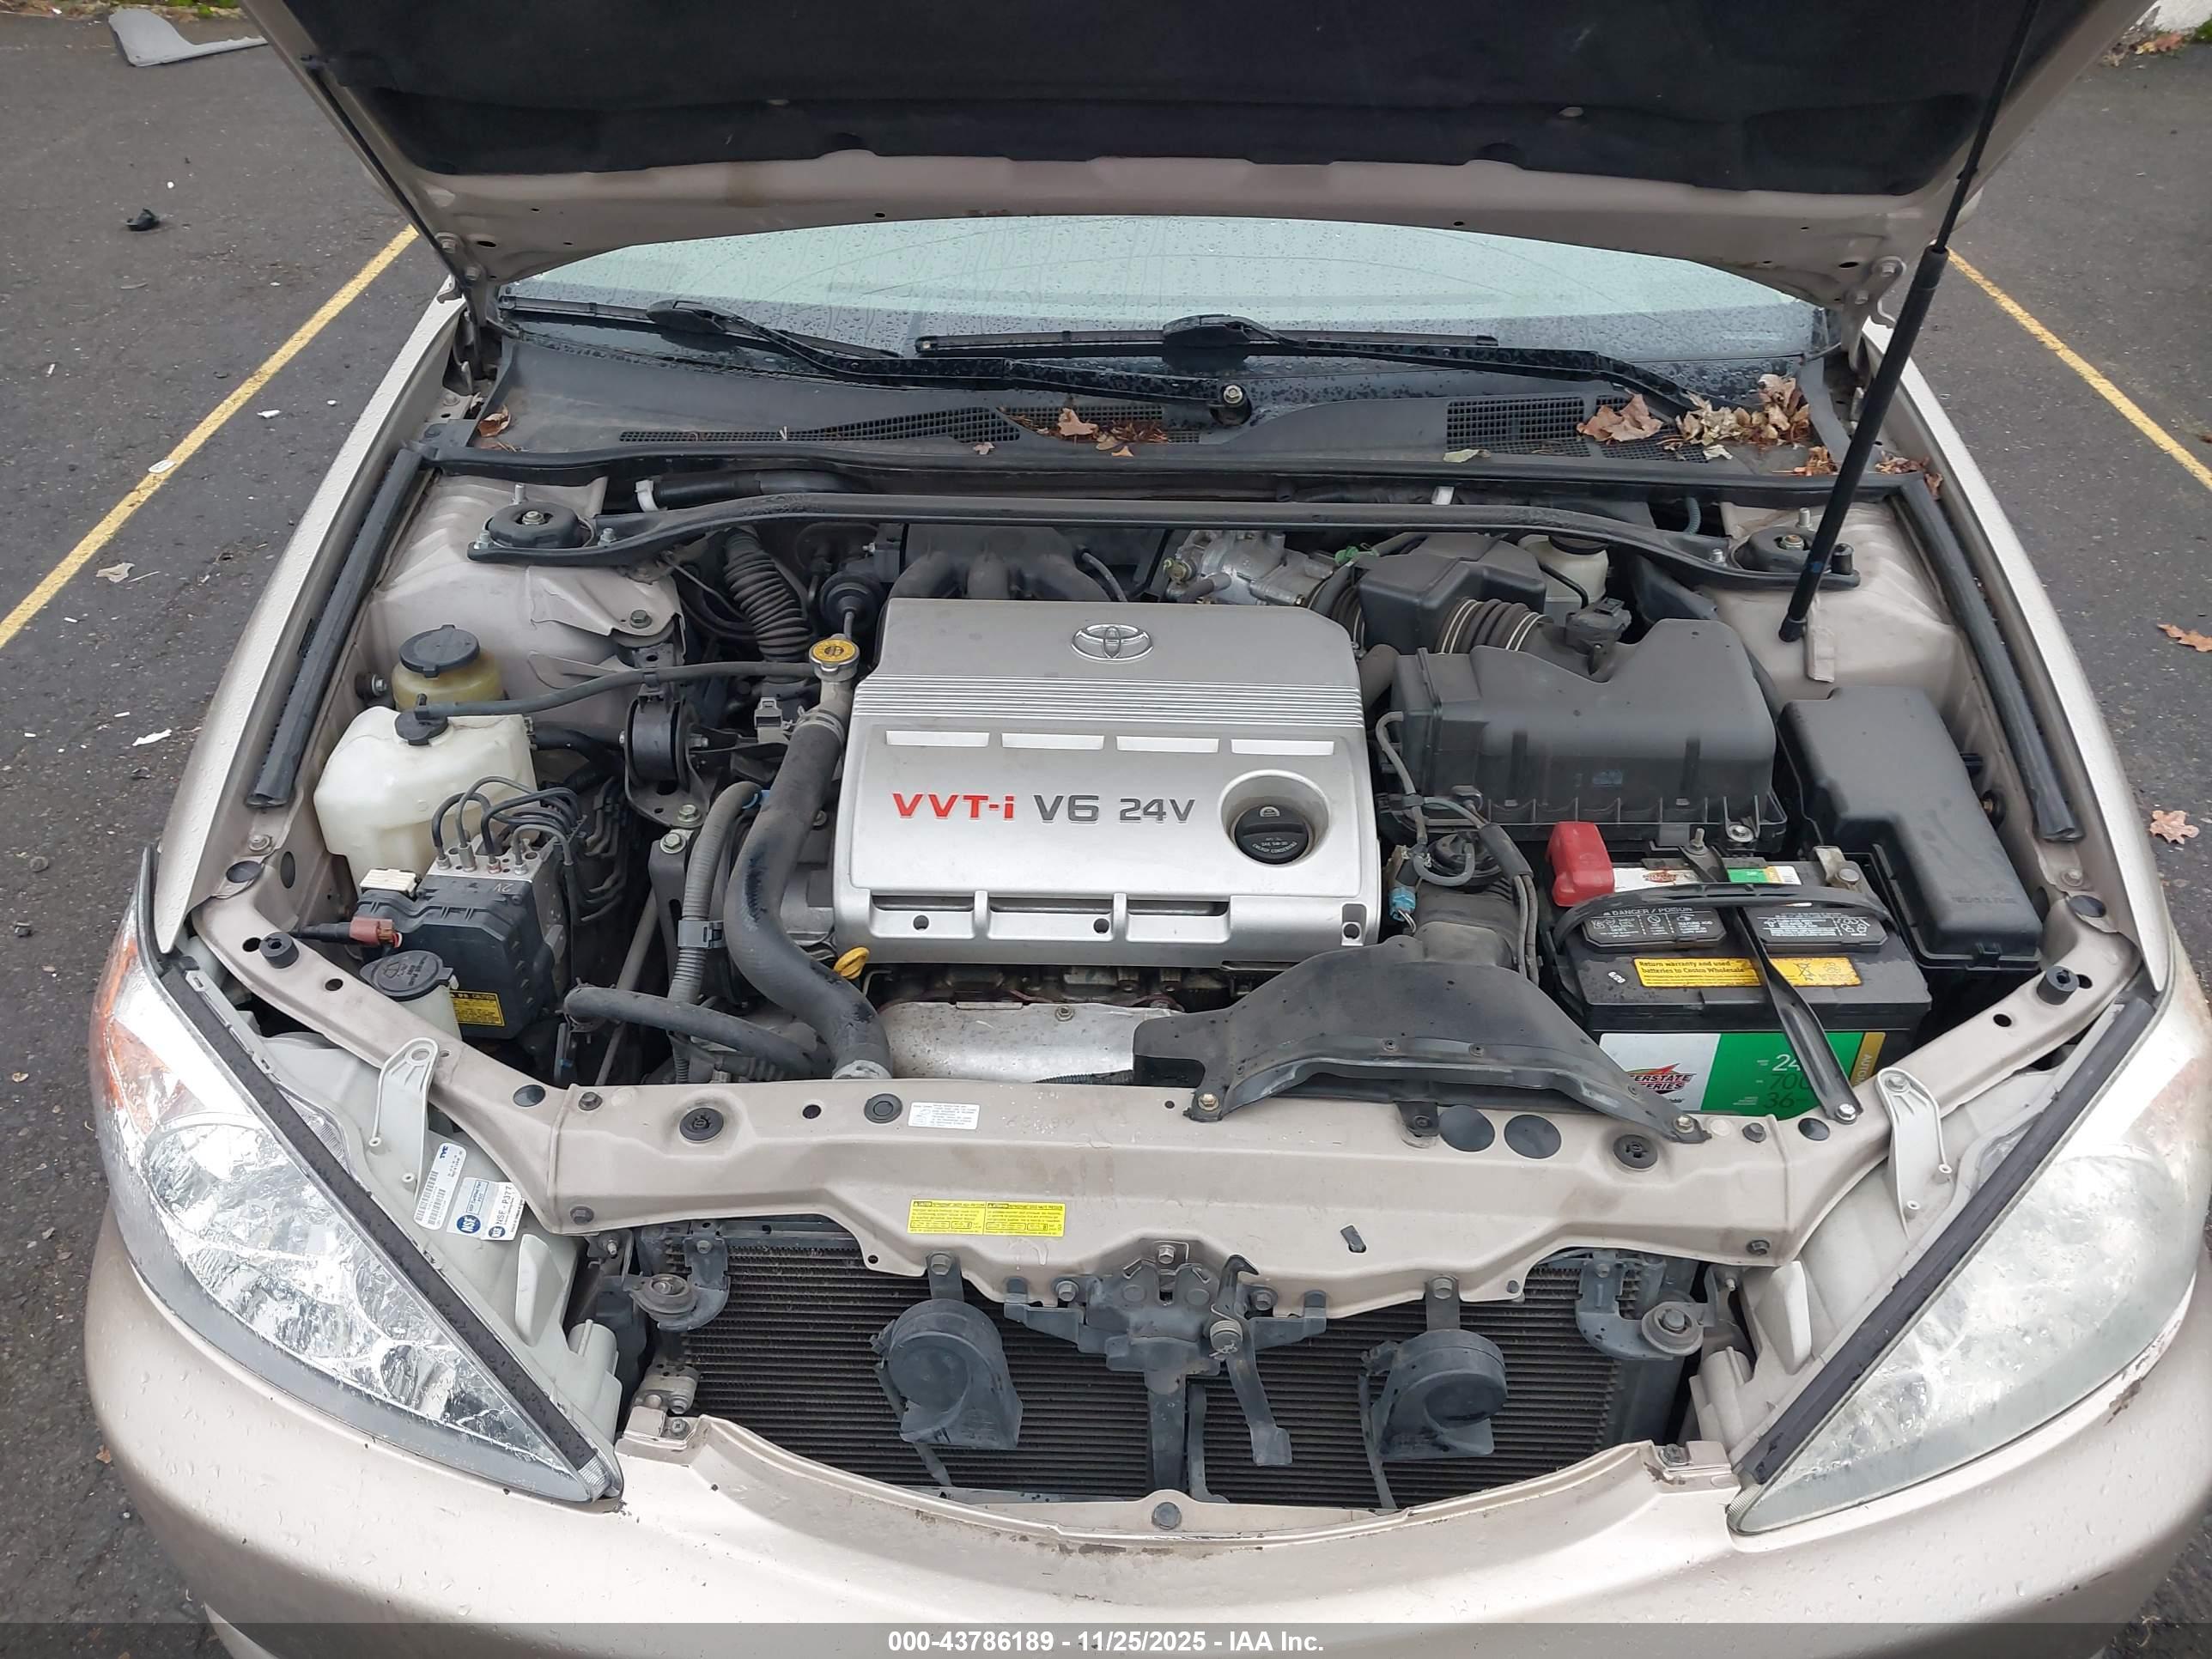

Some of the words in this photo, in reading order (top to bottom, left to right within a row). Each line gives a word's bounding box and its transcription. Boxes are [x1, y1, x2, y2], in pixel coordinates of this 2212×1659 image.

[891, 792, 1018, 819] VVT-i
[1032, 793, 1100, 823] V6
[1118, 797, 1196, 823] 24V
[460, 1216, 477, 1232] NSF
